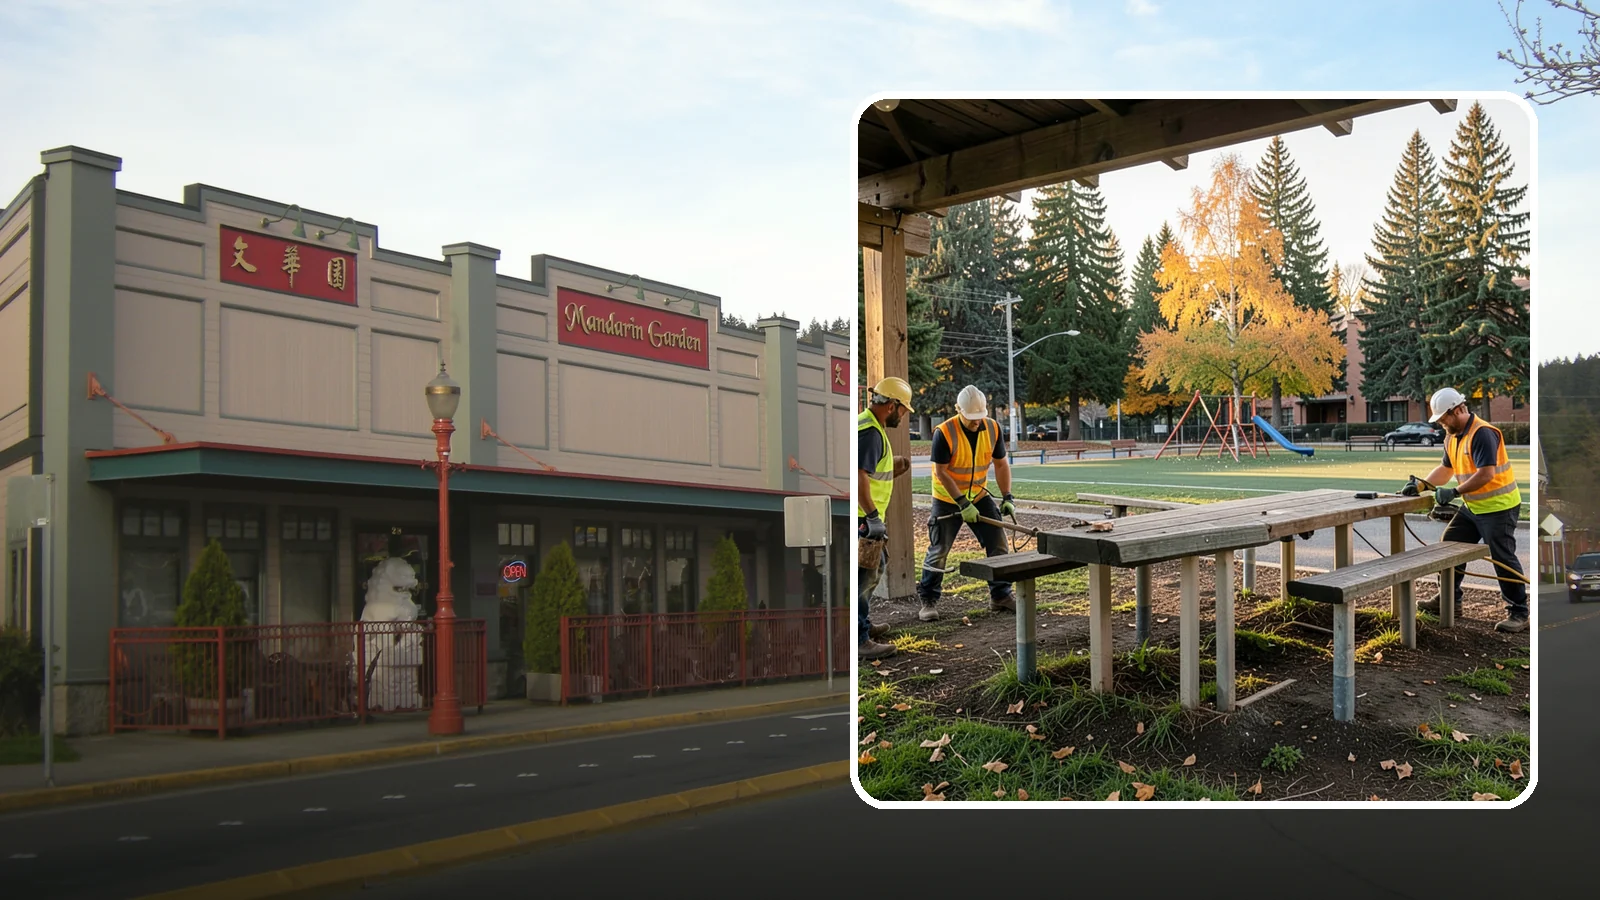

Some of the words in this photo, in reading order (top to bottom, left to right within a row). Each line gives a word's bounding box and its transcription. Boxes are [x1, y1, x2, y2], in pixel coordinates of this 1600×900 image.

[231, 236, 346, 291] 文華園
[564, 302, 644, 341] Mandarin
[648, 320, 701, 352] Garden
[503, 565, 527, 578] OPEN
